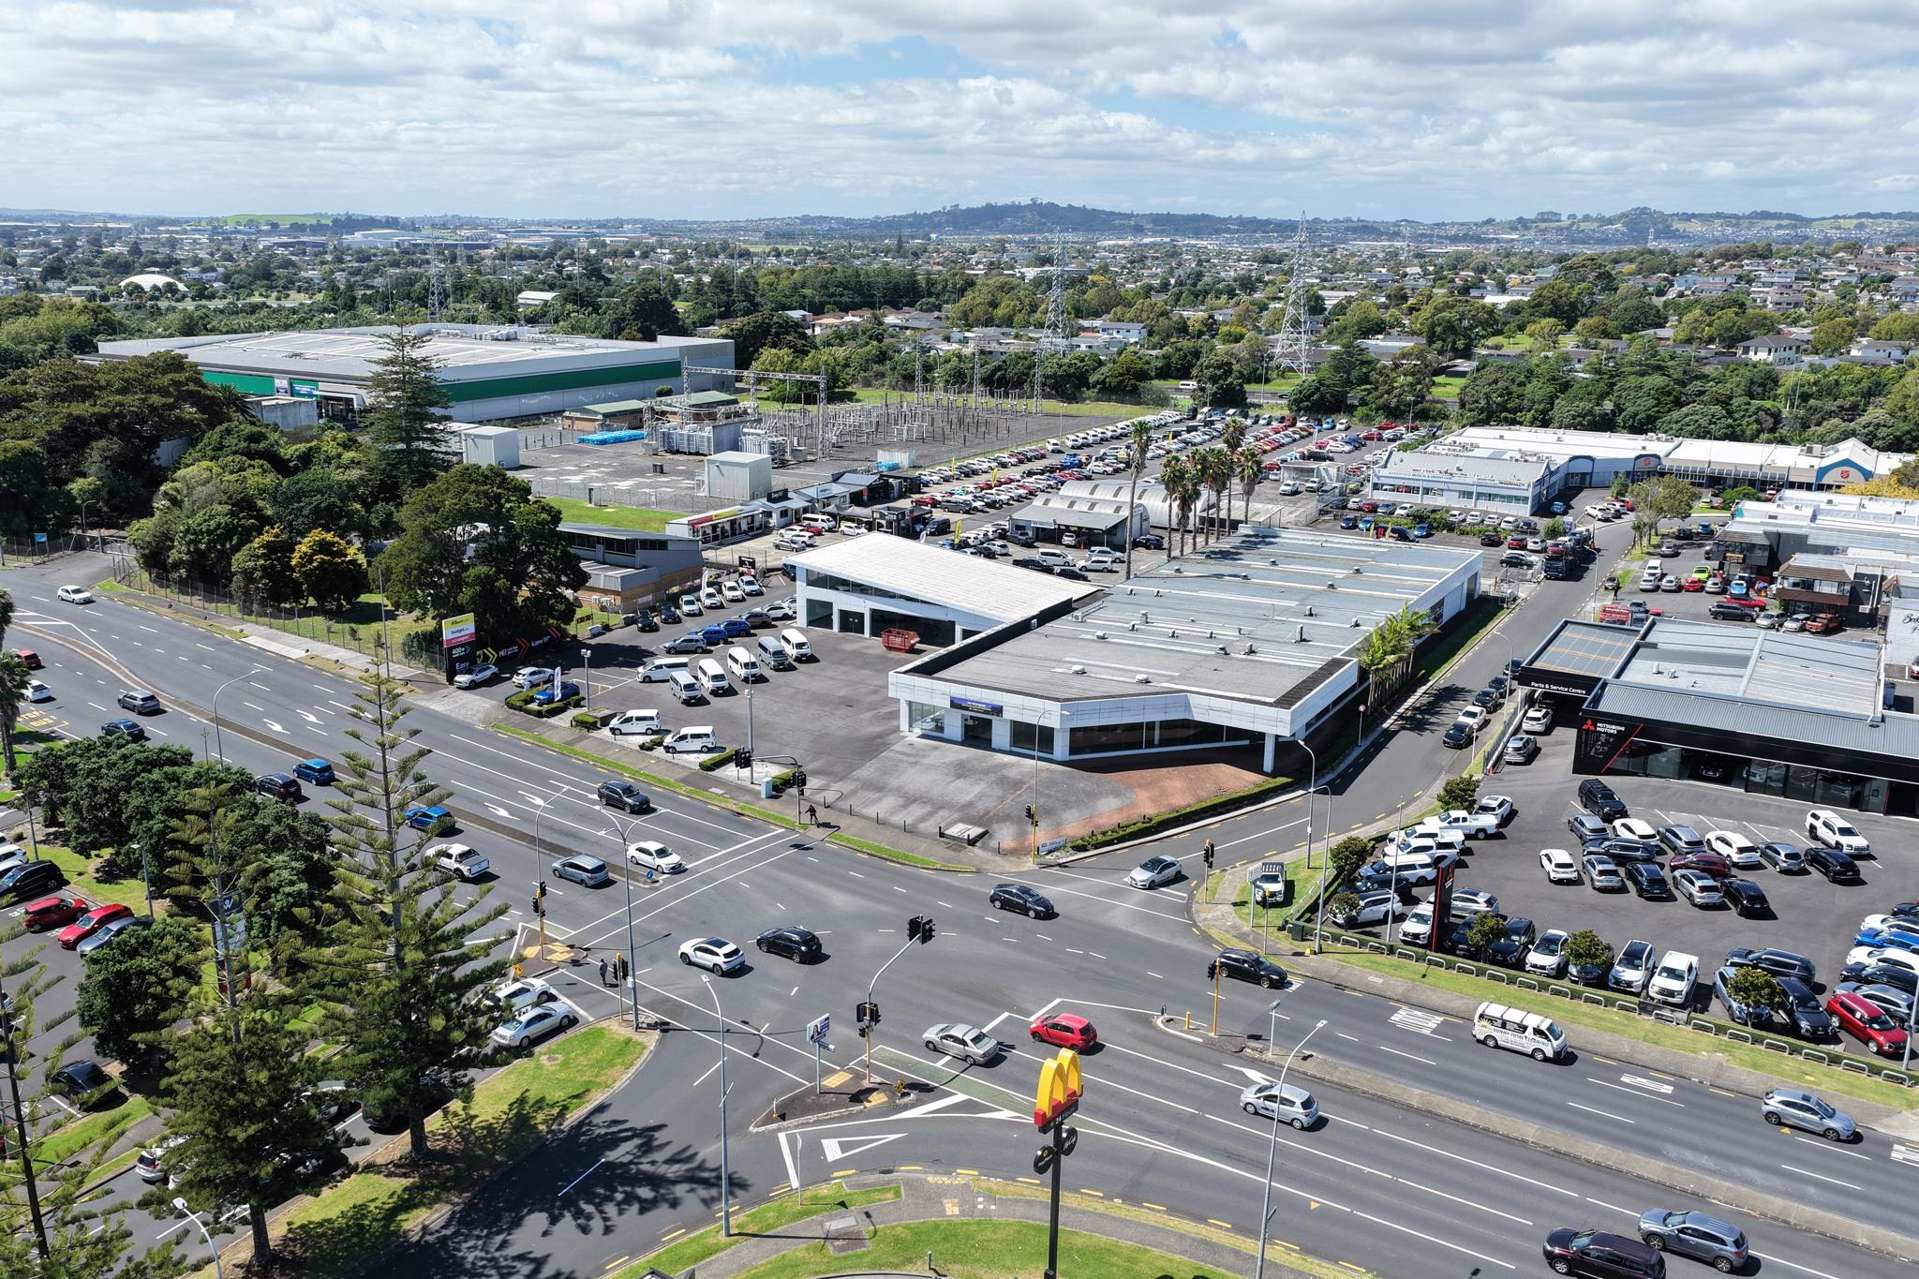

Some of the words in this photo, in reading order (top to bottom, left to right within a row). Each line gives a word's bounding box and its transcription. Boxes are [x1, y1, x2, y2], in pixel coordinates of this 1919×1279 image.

[1531, 681, 1544, 689] Parts
[1550, 684, 1569, 692] Service
[1569, 687, 1586, 695] Centre
[1597, 723, 1625, 731] MITSUBISHI
